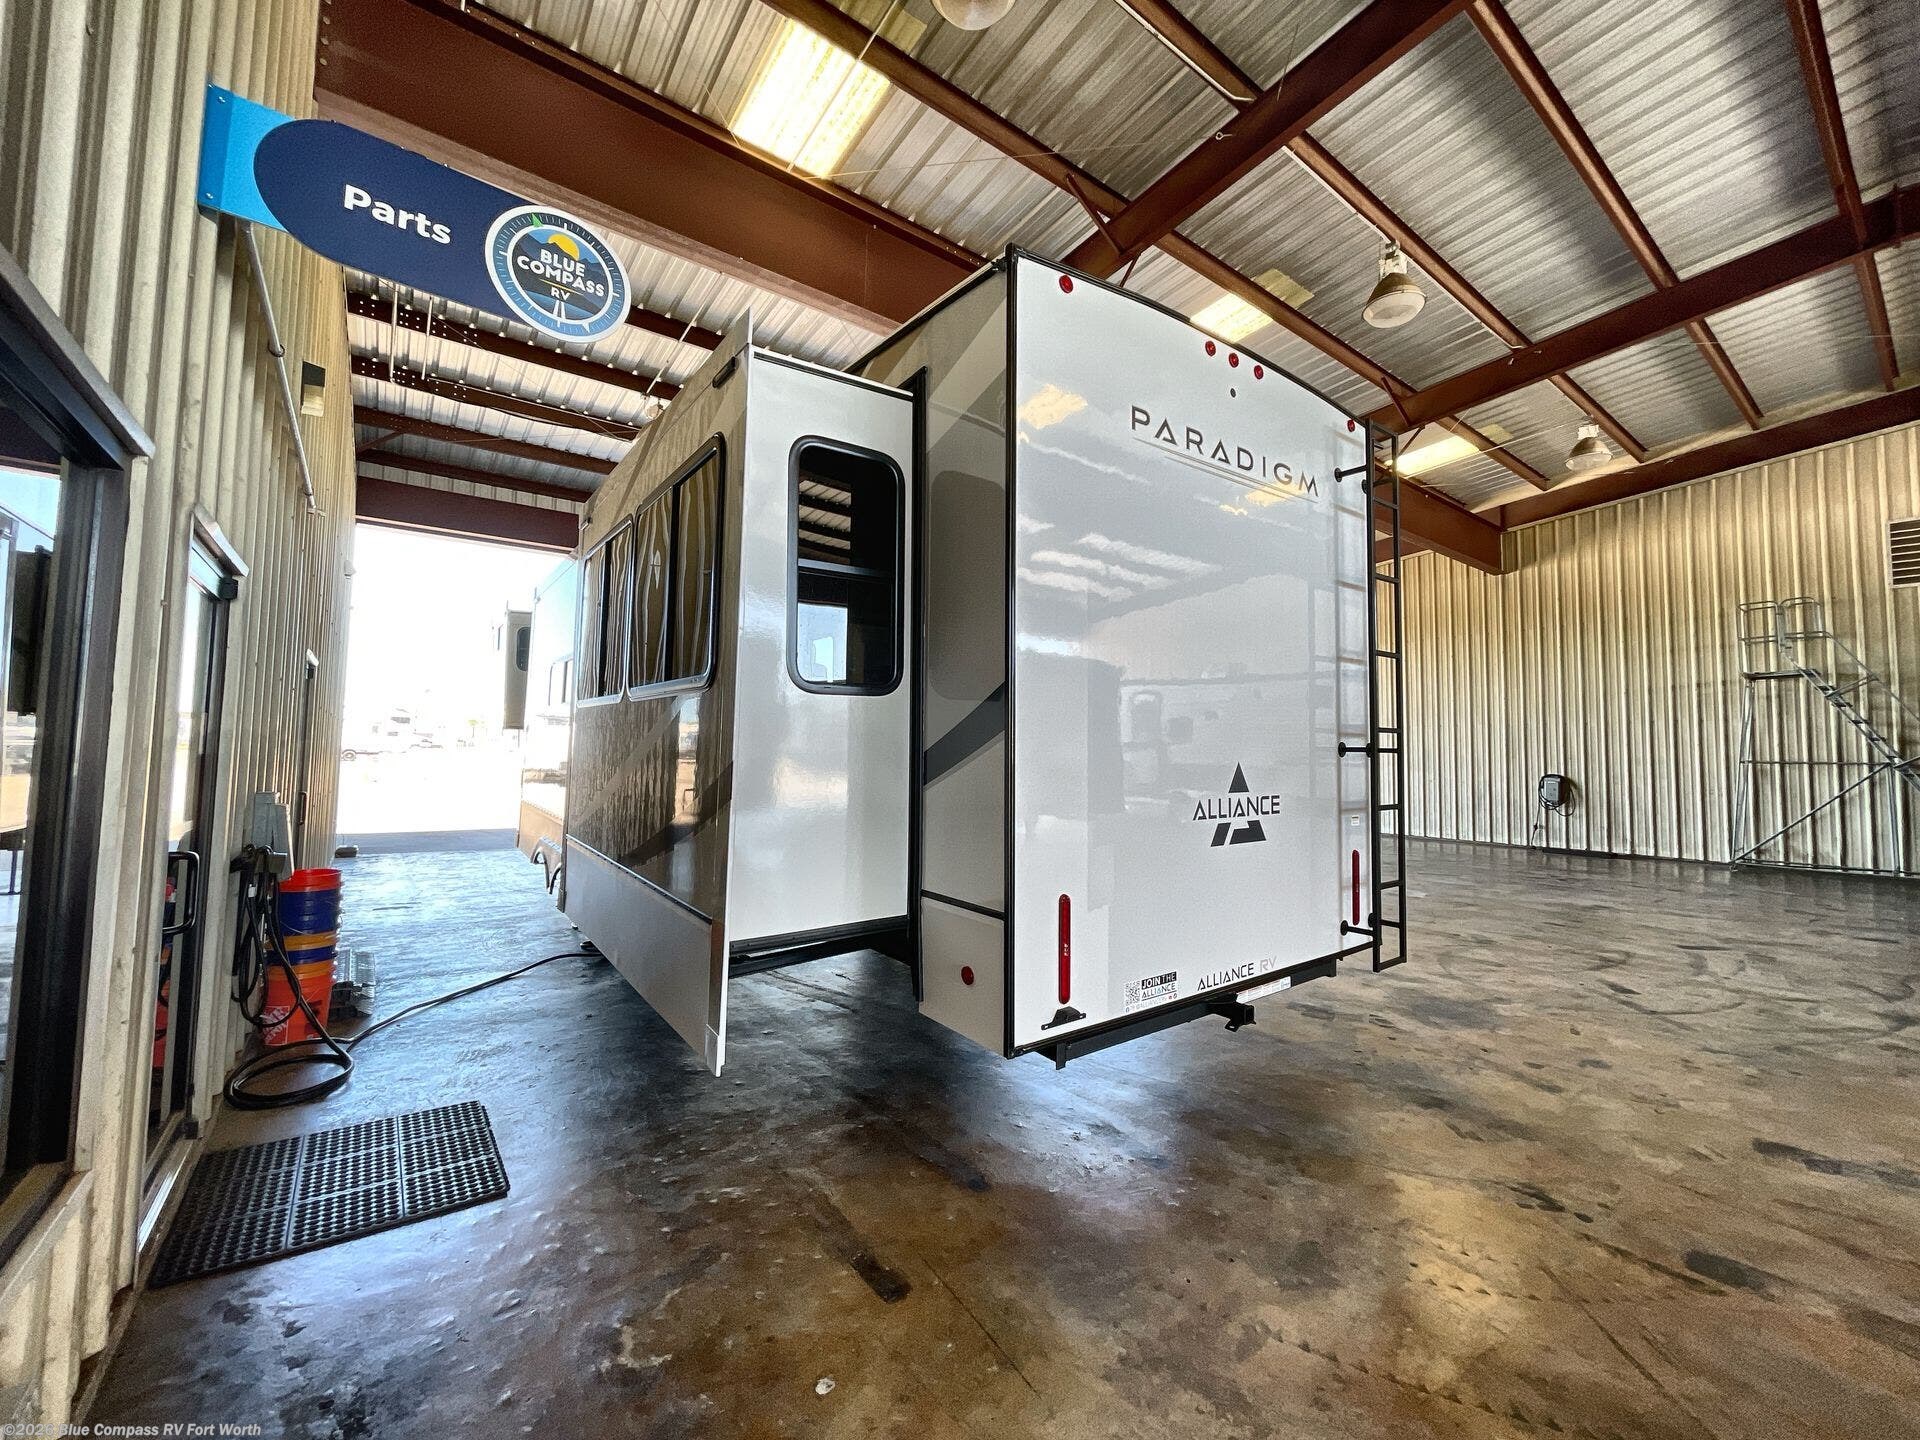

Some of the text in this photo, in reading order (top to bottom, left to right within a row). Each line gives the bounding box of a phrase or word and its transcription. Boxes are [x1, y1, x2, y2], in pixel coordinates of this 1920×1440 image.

[344, 184, 451, 244] Parts
[517, 255, 605, 297] COMPASS
[540, 248, 586, 278] BLUE
[551, 286, 571, 301] RV
[1131, 405, 1319, 497] PARADIGM
[1192, 795, 1280, 821] ALLIANCE
[1142, 972, 1176, 989] JOIN THE
[1197, 962, 1254, 991] ALLIANCE
[1260, 956, 1277, 973] RV
[1142, 983, 1176, 999] ALLIANCE
